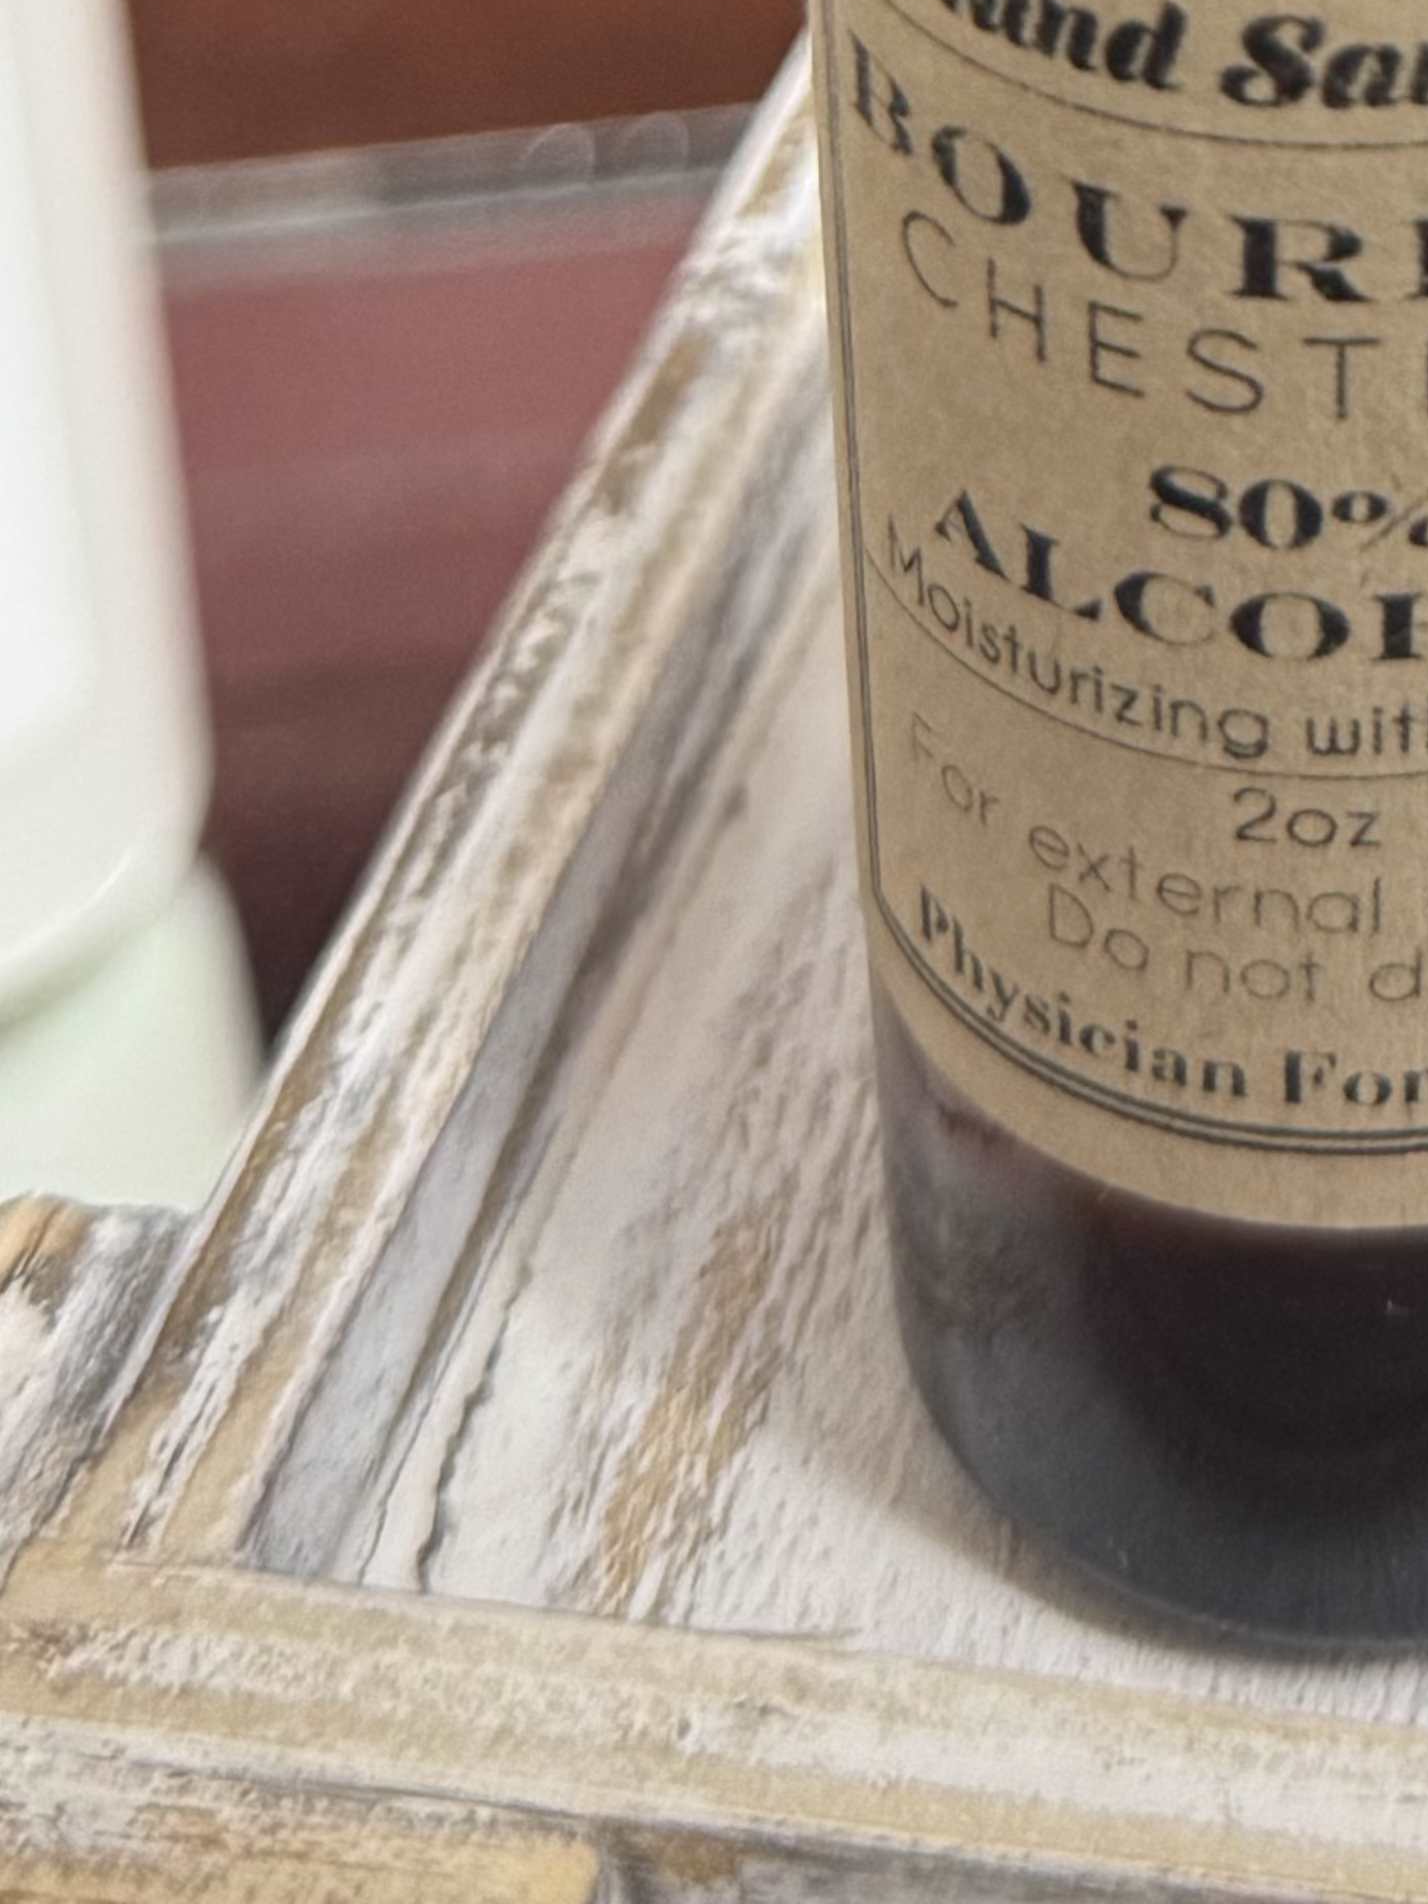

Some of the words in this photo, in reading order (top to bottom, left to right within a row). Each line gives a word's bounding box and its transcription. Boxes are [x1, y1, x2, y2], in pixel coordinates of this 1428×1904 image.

[888, 516, 1271, 760] Moisturizing
[907, 712, 998, 828] For
[1029, 823, 1383, 935] external
[1232, 785, 1382, 849] 2oz
[915, 884, 1246, 1101] Physician
[1047, 881, 1150, 973] Do
[1186, 944, 1322, 1004] not
